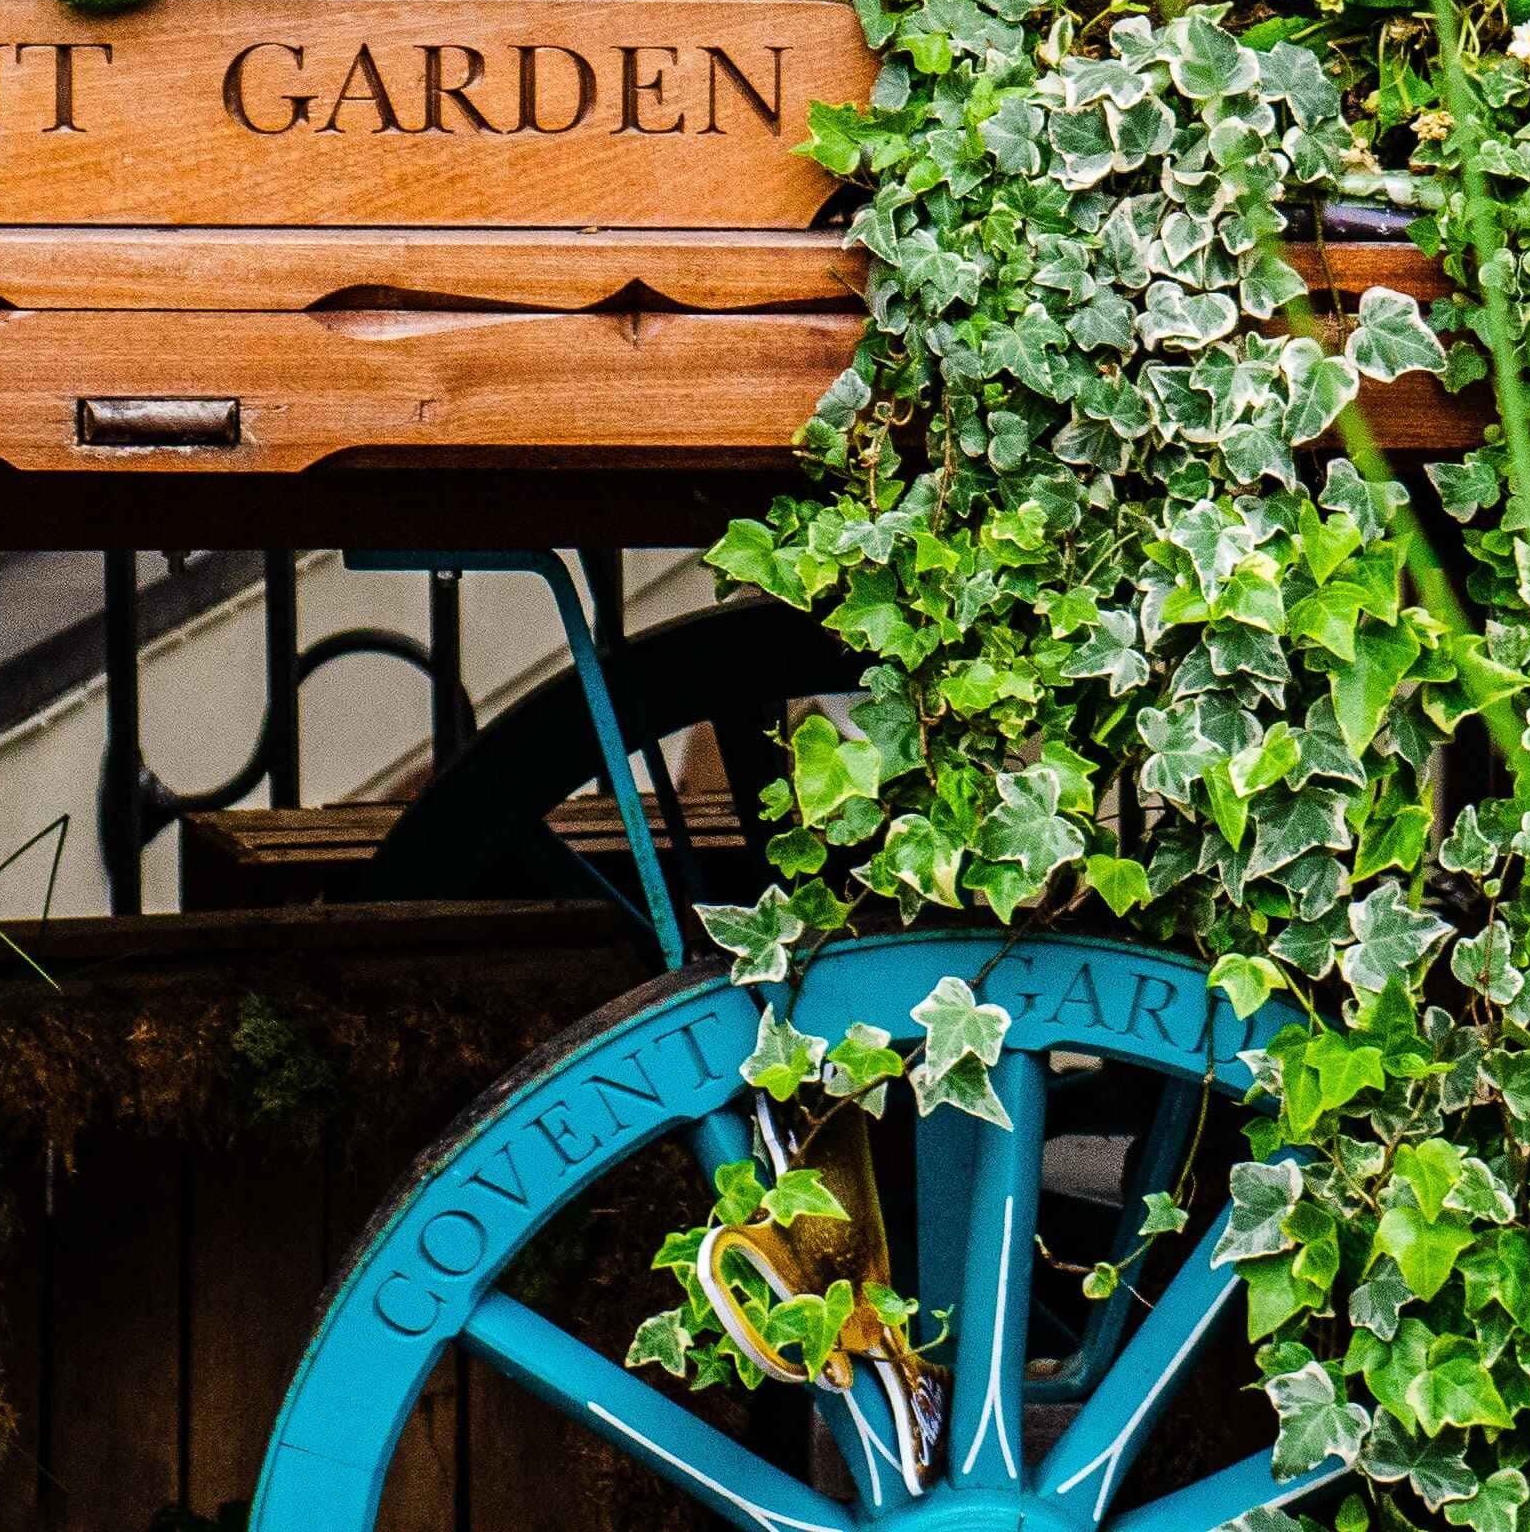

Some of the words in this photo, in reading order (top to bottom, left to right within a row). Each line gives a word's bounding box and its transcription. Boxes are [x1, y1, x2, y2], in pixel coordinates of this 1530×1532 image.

[222, 41, 795, 137] GARDEN
[372, 1011, 724, 1337] COVENT
[975, 953, 1256, 1064] GARD
